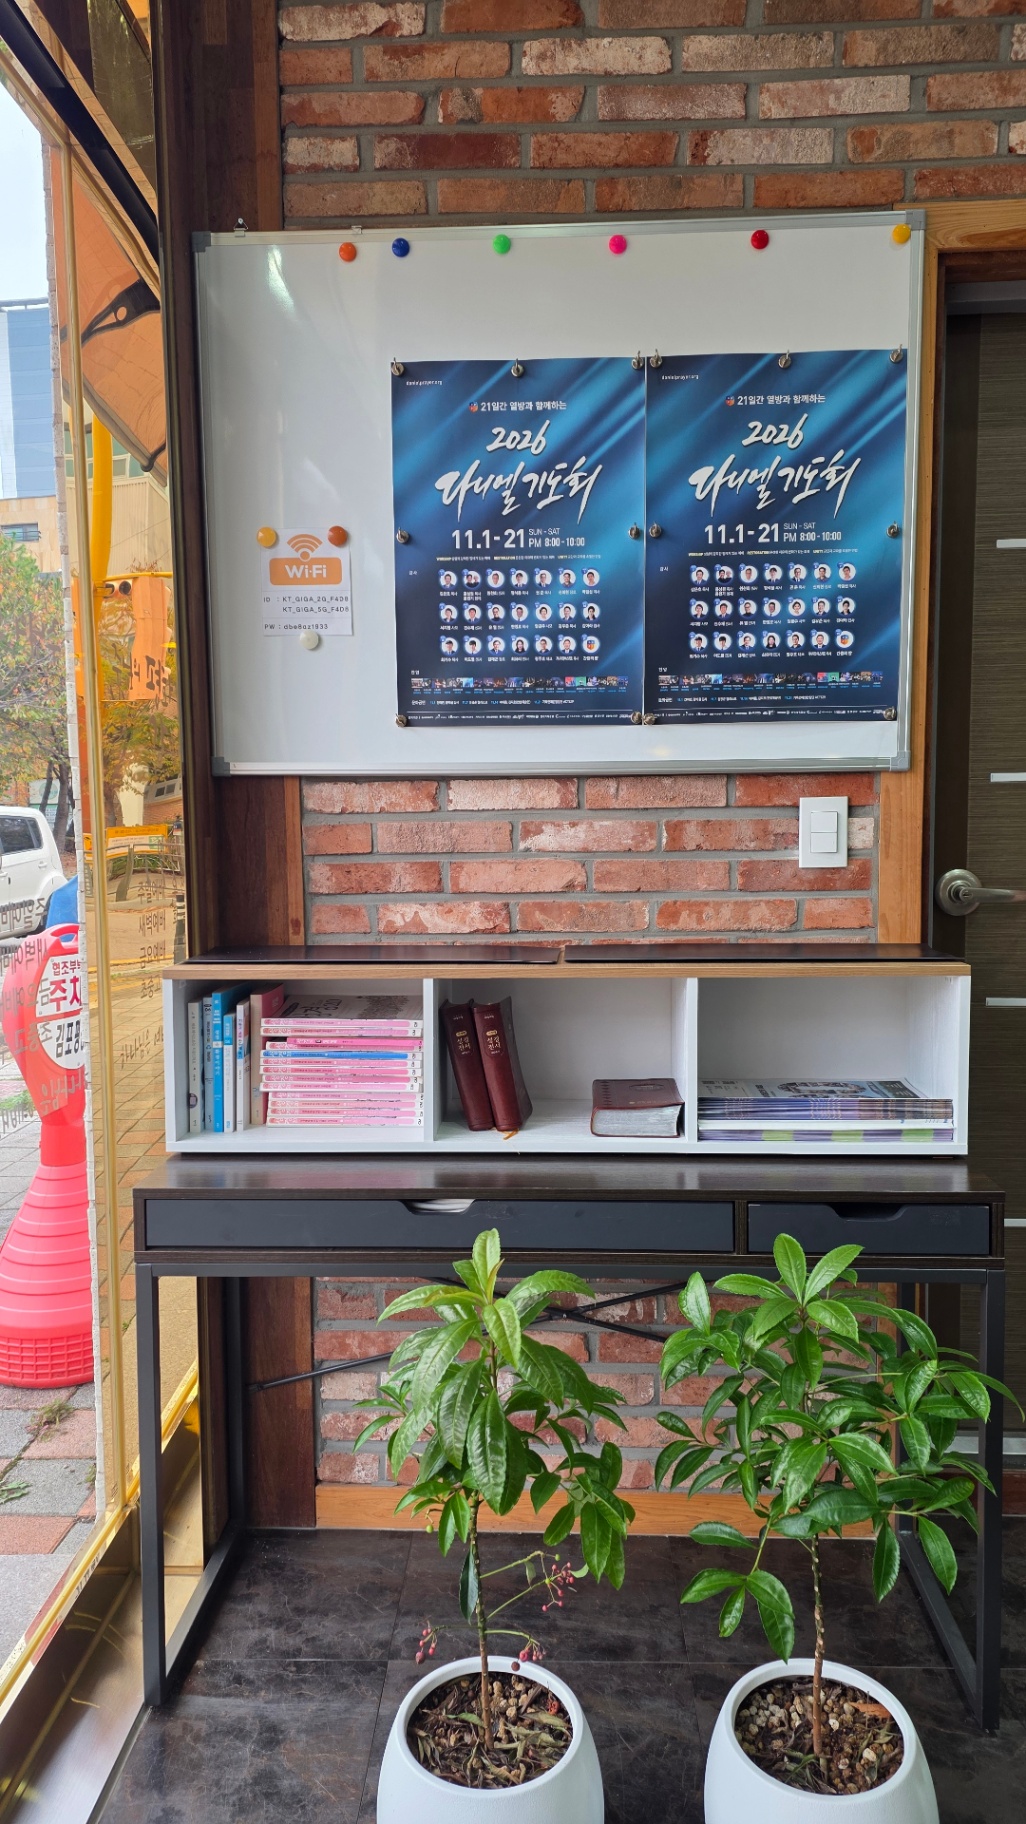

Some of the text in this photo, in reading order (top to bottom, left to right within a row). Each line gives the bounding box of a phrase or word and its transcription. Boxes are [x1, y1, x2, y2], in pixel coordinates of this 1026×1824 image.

[737, 393, 826, 406] 21일간 열방과 함께하는
[480, 400, 567, 412] 21일간 열방과 함께하는
[486, 419, 550, 455] 2026
[741, 413, 808, 449] 2026
[528, 538, 542, 548] PM
[783, 533, 797, 543] PM
